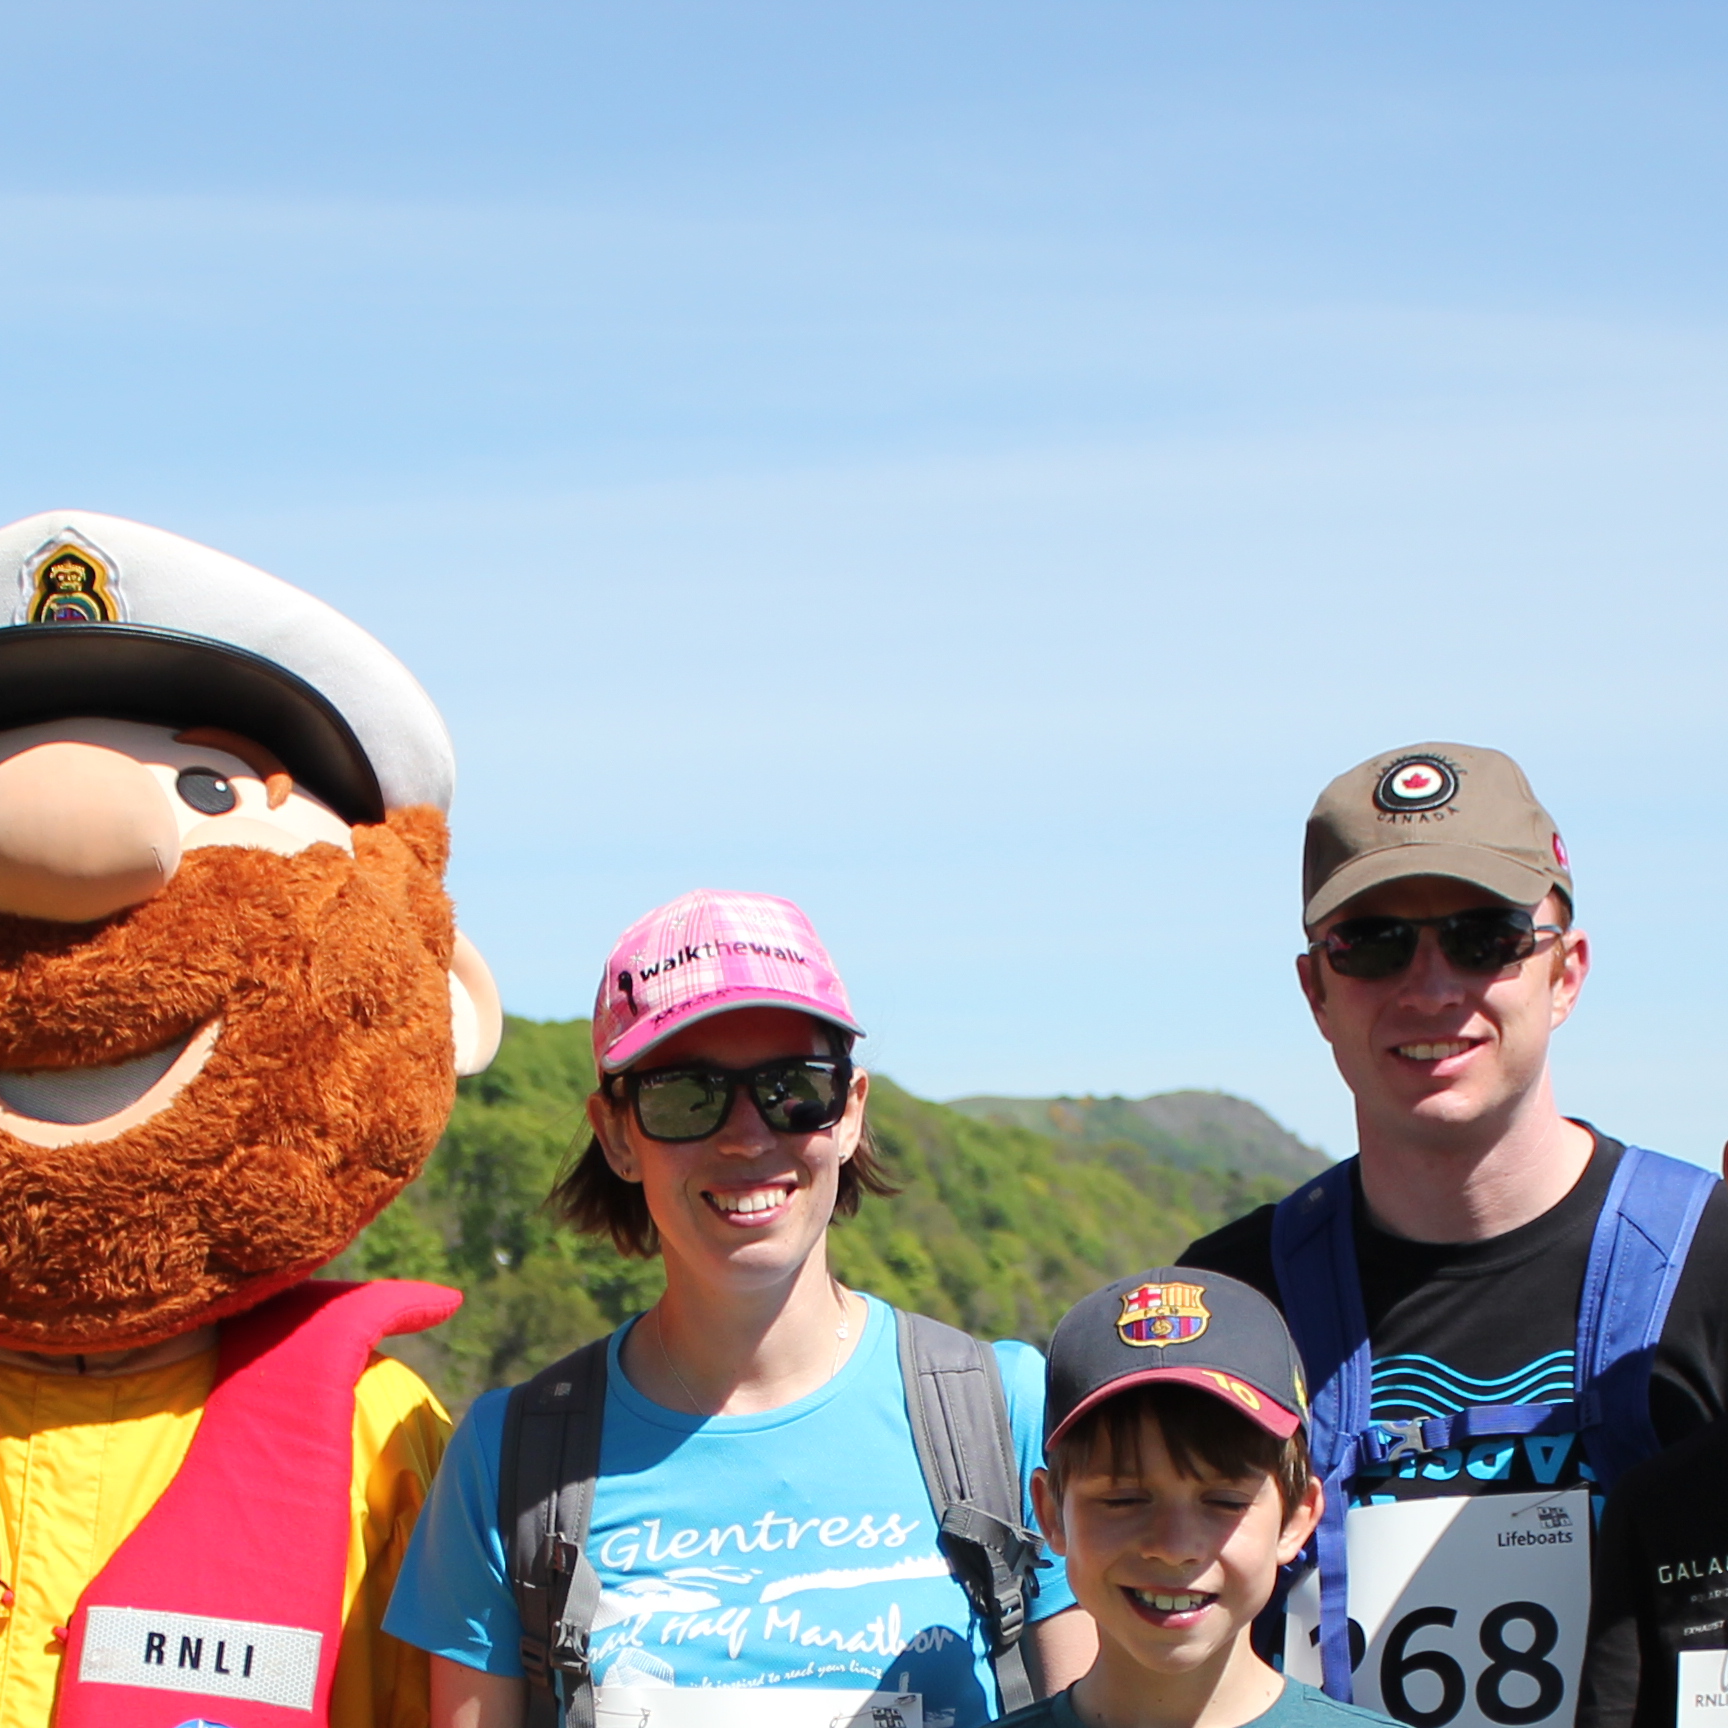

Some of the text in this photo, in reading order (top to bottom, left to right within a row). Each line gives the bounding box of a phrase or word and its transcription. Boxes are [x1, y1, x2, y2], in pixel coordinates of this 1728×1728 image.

[1377, 804, 1460, 824] CANADA
[599, 1509, 921, 1573] Glentress
[1497, 1531, 1574, 1548] Lifeboats
[143, 1631, 255, 1678] RNLI
[660, 1607, 753, 1661] Half
[763, 1602, 955, 1657] Marathon
